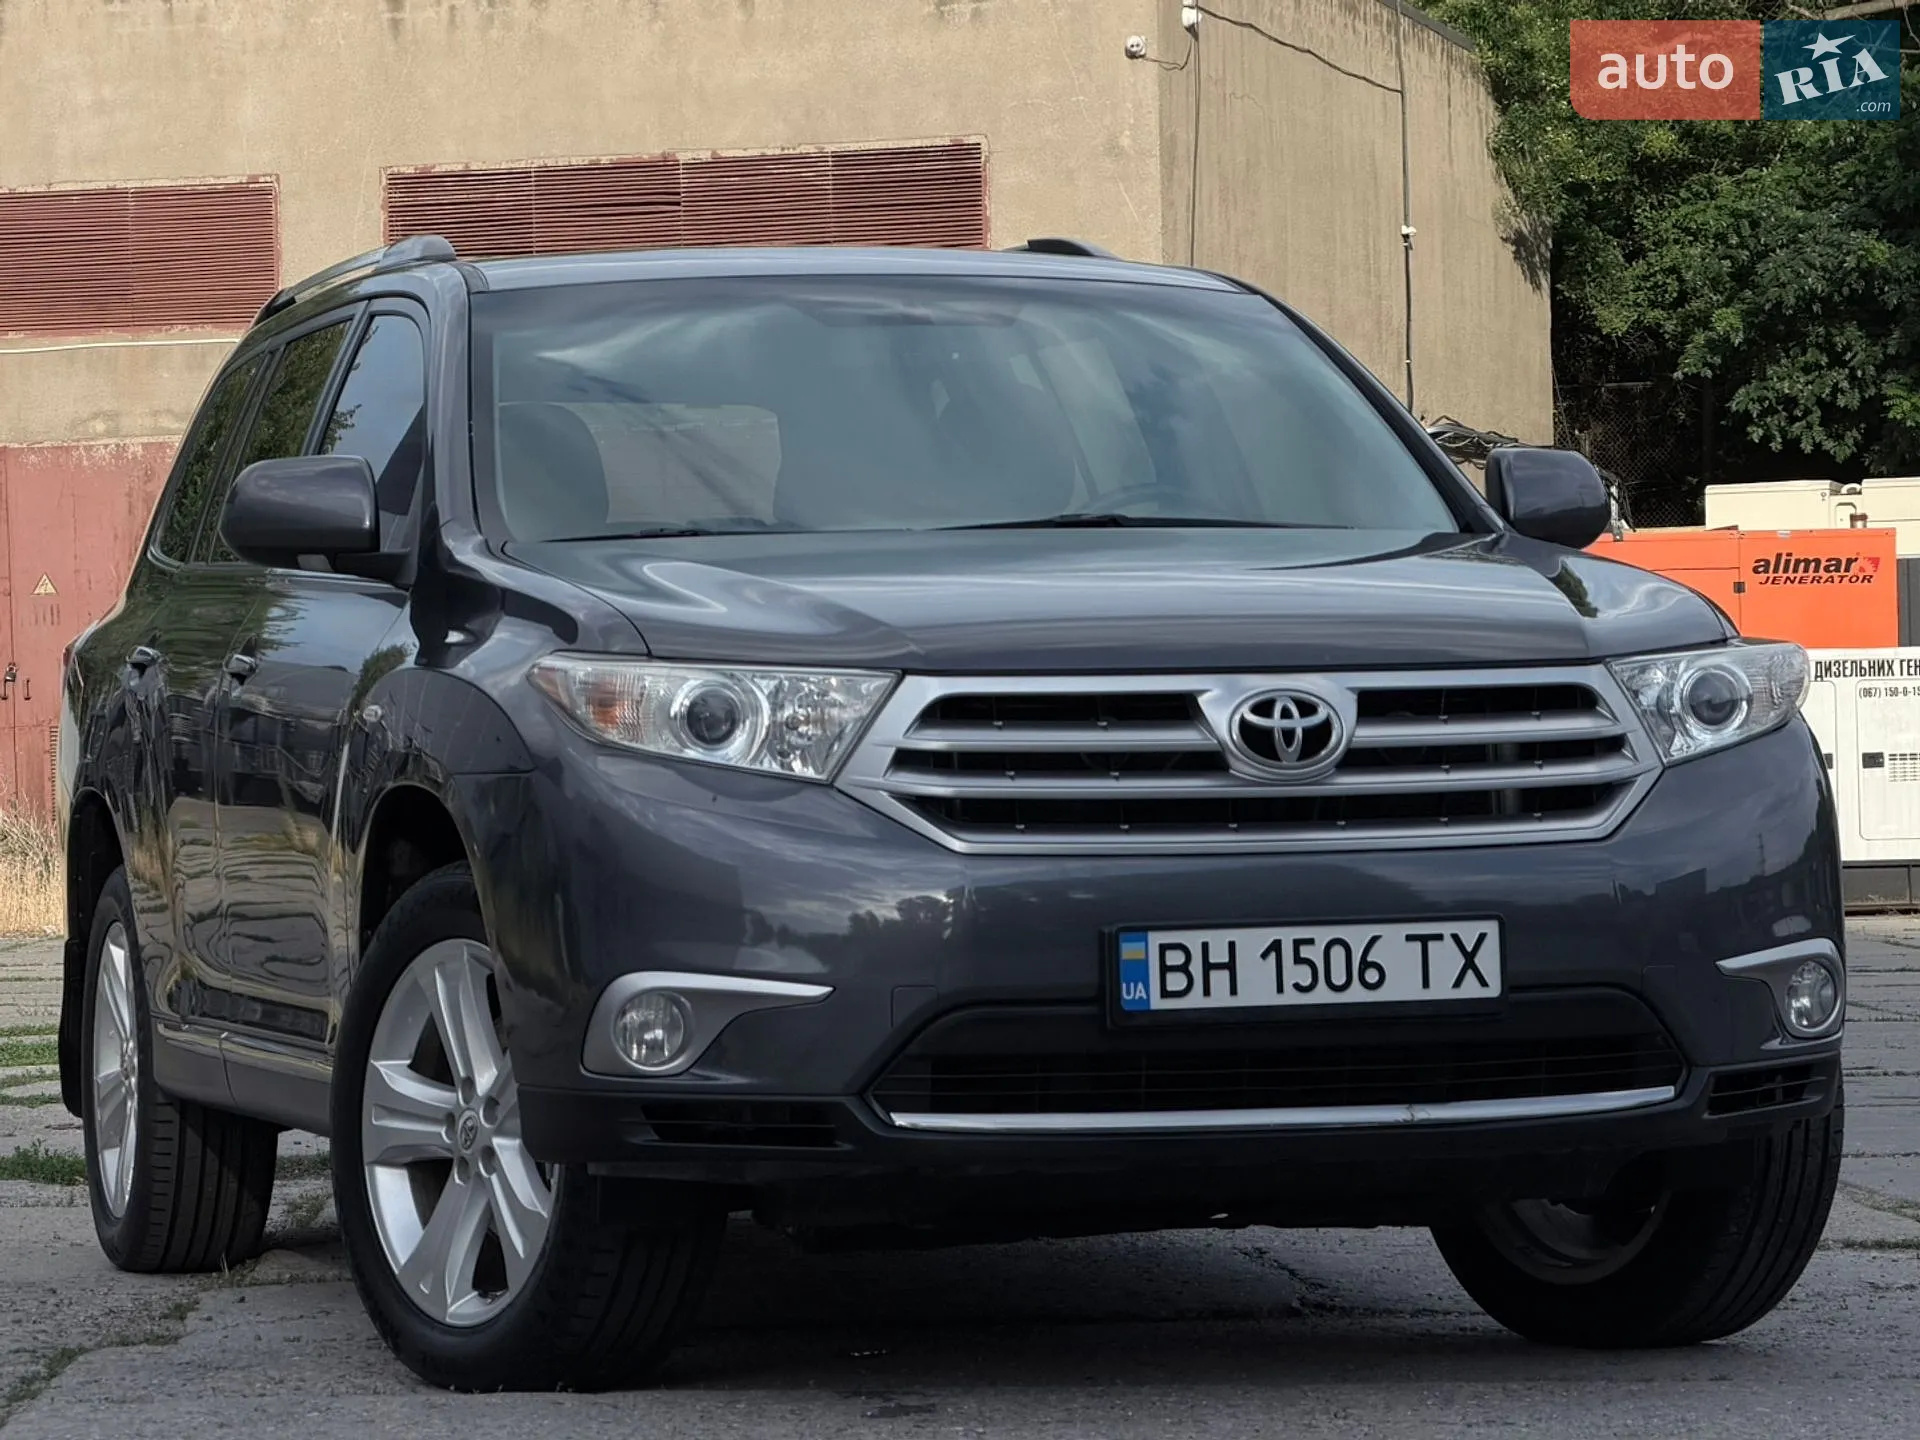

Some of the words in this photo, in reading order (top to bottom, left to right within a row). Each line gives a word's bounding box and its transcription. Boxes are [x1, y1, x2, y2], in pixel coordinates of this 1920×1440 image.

[1752, 552, 1859, 574] alimar
[1814, 659, 1895, 681] ДИЗЕЛЬНИХ
[1859, 686, 1882, 699] (067)
[1158, 940, 1239, 999] BH
[1259, 934, 1387, 995] 1506
[1405, 932, 1490, 990] TX
[1121, 982, 1147, 1000] UA
